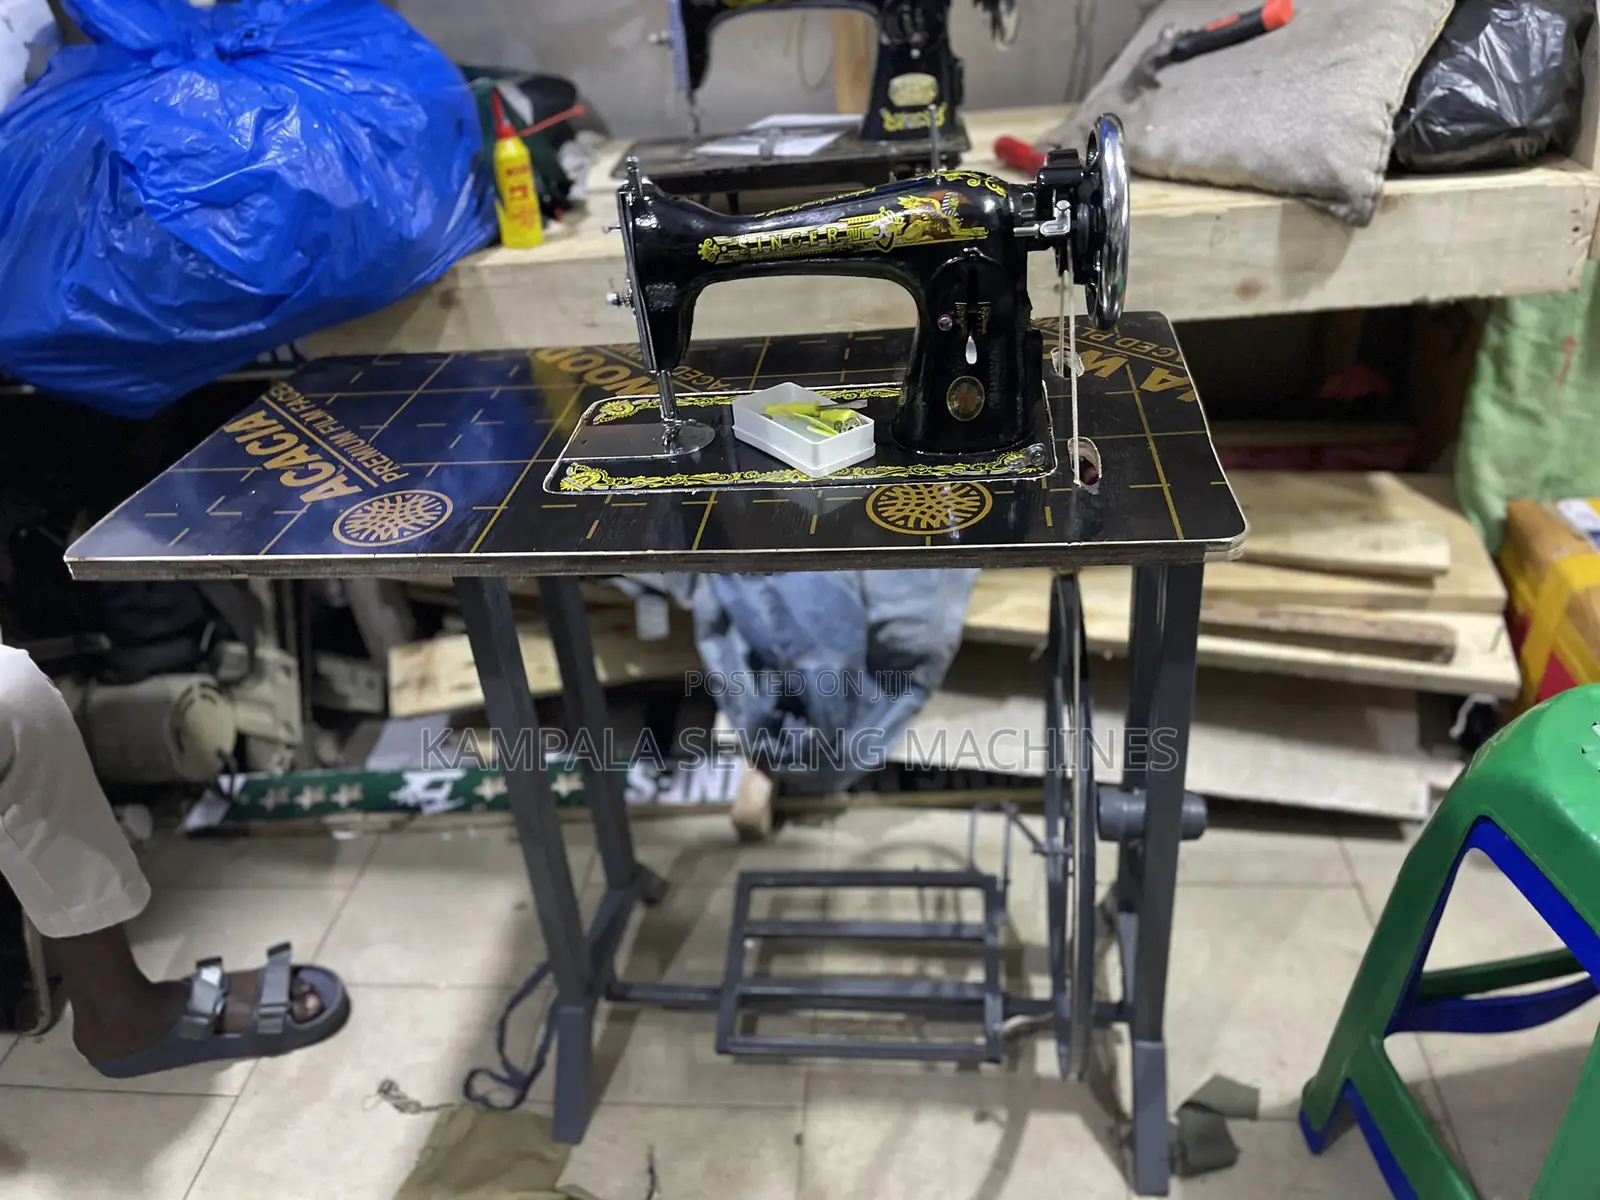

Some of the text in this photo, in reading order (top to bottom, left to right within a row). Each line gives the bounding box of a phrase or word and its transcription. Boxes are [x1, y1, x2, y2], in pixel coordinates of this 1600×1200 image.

[737, 228, 841, 255] SINGER
[300, 407, 345, 436] FILM
[223, 409, 364, 503] ACACIA
[328, 429, 410, 484] PREMIUM
